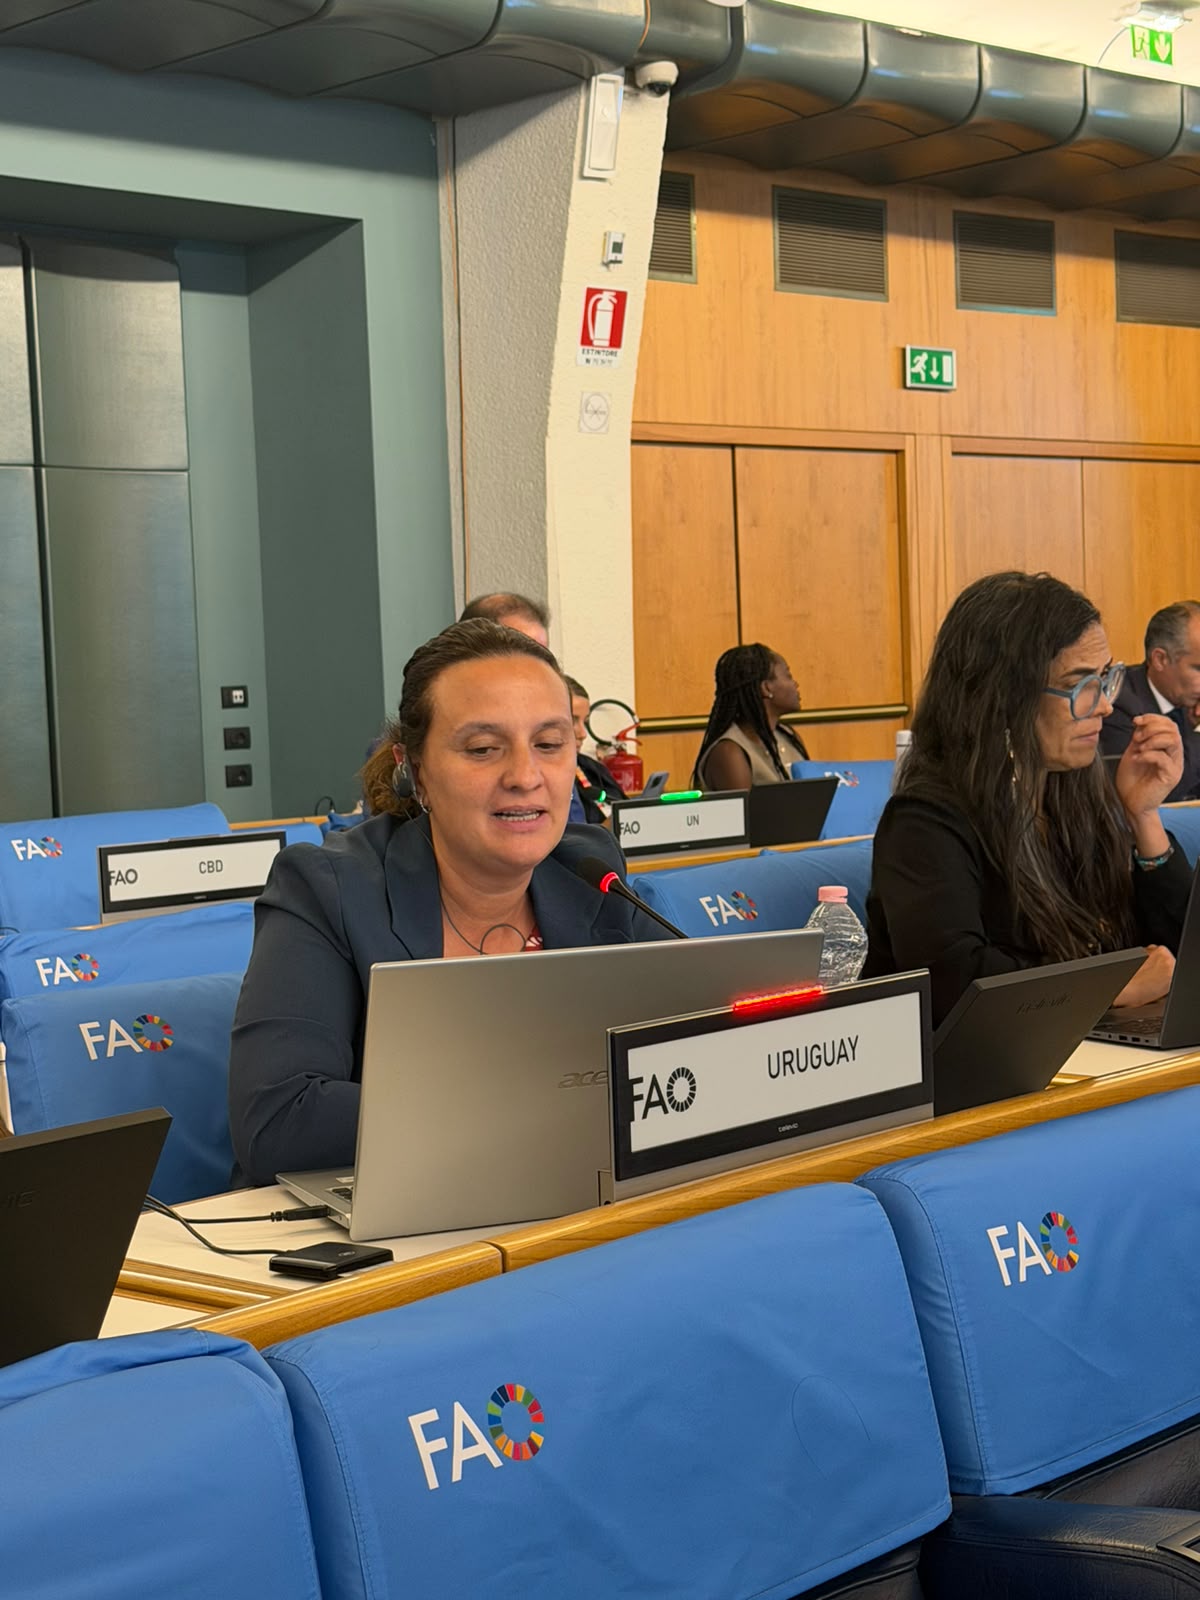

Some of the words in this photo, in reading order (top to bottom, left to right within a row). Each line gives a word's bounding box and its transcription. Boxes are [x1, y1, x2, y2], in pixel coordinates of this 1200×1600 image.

[619, 821, 641, 836] FAO
[686, 814, 700, 827] UN
[11, 836, 63, 861] FAO
[108, 868, 139, 886] FAO
[198, 859, 224, 875] CBD
[699, 890, 758, 927] FAO
[35, 953, 99, 987] FAO
[79, 1013, 174, 1061] FAO
[767, 1035, 860, 1079] URUGUAY
[558, 1070, 608, 1088] ace
[630, 1066, 697, 1121] FAO
[986, 1211, 1080, 1287] FAO
[408, 1383, 545, 1490] FAO
